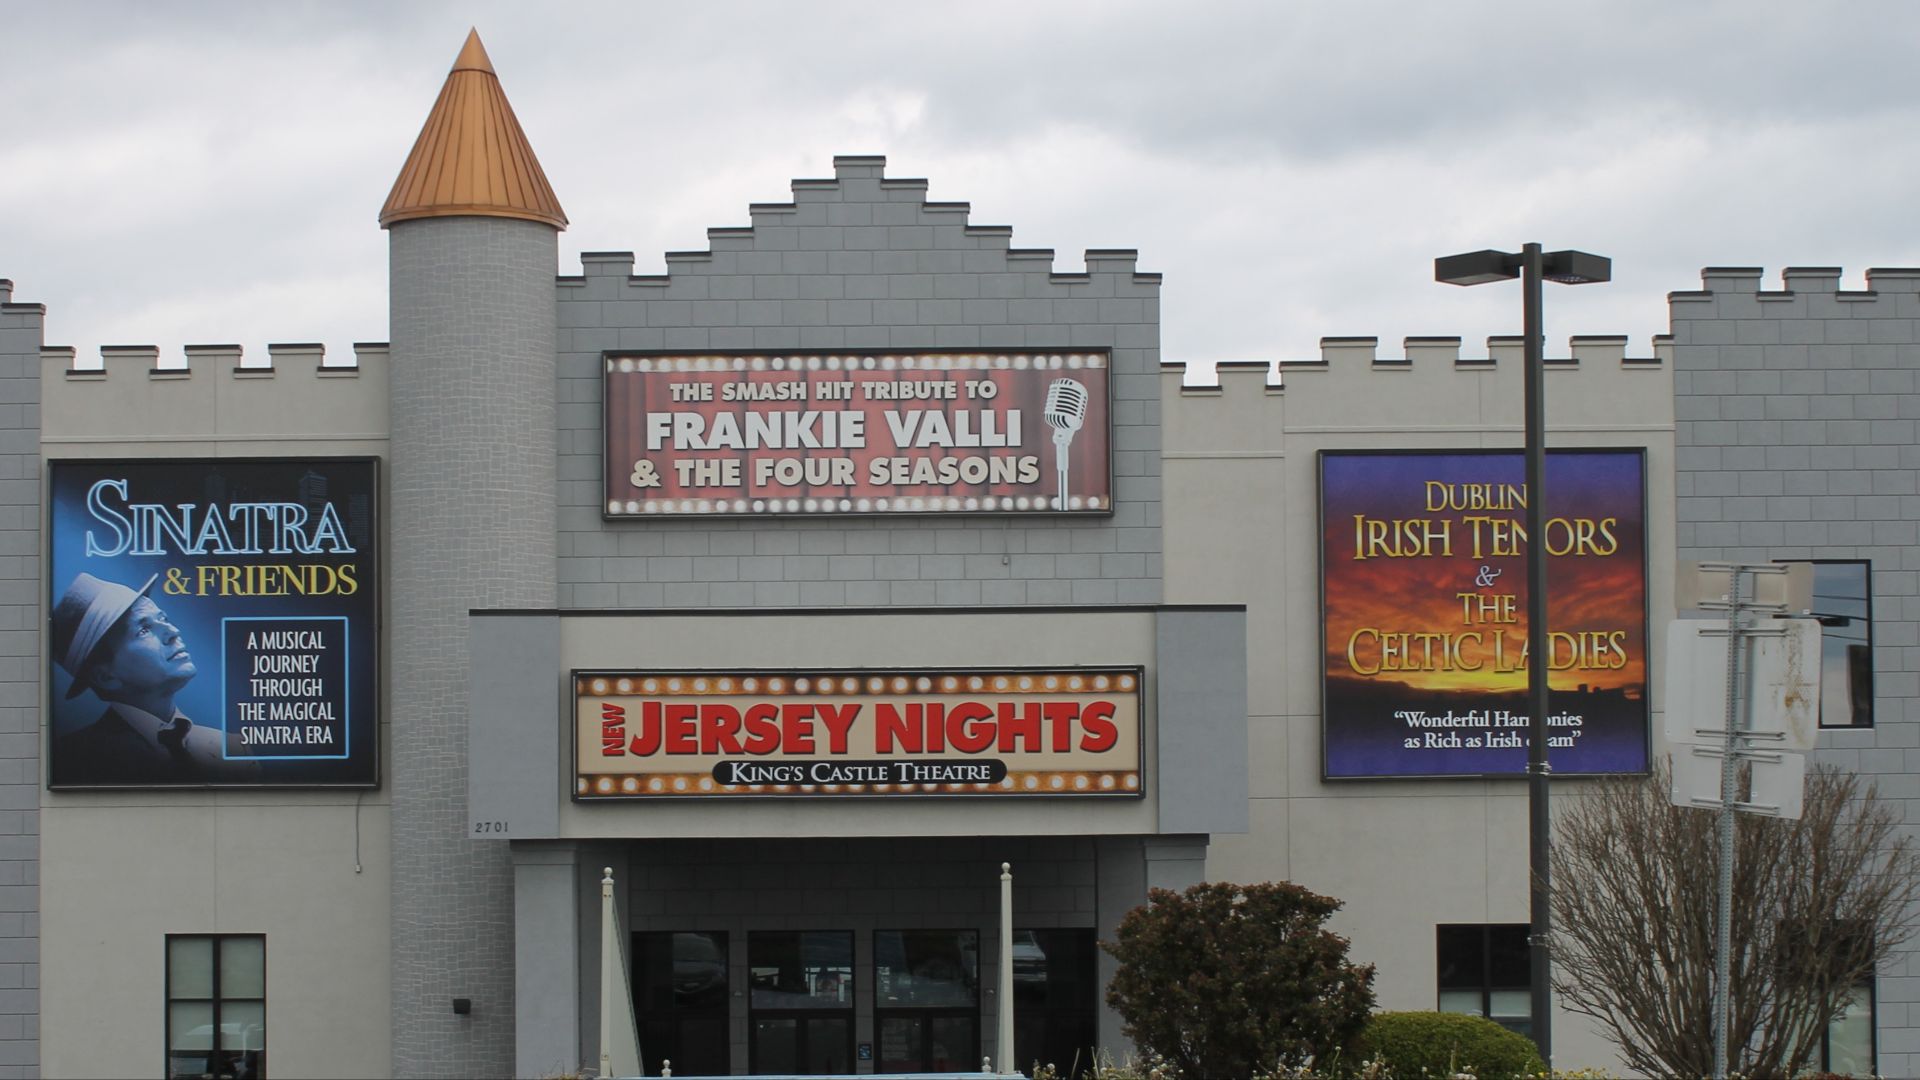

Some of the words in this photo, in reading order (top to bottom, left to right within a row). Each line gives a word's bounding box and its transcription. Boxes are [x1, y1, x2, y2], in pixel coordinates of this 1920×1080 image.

[670, 381, 714, 402] THE
[721, 380, 807, 401] SMASH
[816, 380, 854, 400] HIT
[862, 379, 957, 400] TRIBUTE
[965, 379, 998, 399] TO
[646, 409, 866, 450] FRANKIE
[883, 408, 1022, 448] VALLI
[629, 459, 661, 488] &
[674, 458, 742, 487] THE
[755, 457, 856, 487] FOUR
[869, 455, 1040, 486] SEASONS
[1424, 481, 1528, 511] DUBLIN
[85, 478, 357, 557] SINATRA
[1353, 514, 1453, 560] IRISH
[163, 567, 191, 595] &
[195, 563, 358, 597] FRIENDS
[1475, 565, 1502, 587] &
[1456, 592, 1519, 625] THE
[247, 632, 258, 650] A
[262, 631, 326, 650] MUSICAL
[1347, 627, 1483, 676] CELTIC
[253, 654, 320, 675] JOURNEY
[250, 678, 323, 697] THROUGH
[238, 702, 266, 721] THE
[270, 701, 336, 721] MAGICAL
[241, 725, 302, 744] SINATRA
[306, 725, 333, 744] ERA
[602, 702, 626, 757] NEW
[629, 701, 862, 758] JERSEY
[874, 701, 1119, 755] NIGHTS
[1404, 736, 1421, 749] as
[1424, 732, 1462, 749] Rich
[1465, 736, 1482, 748] as
[1485, 730, 1522, 748] Irish
[810, 762, 888, 783] CASTLE
[894, 762, 991, 782] THEATRE
[475, 821, 508, 833] 2701
